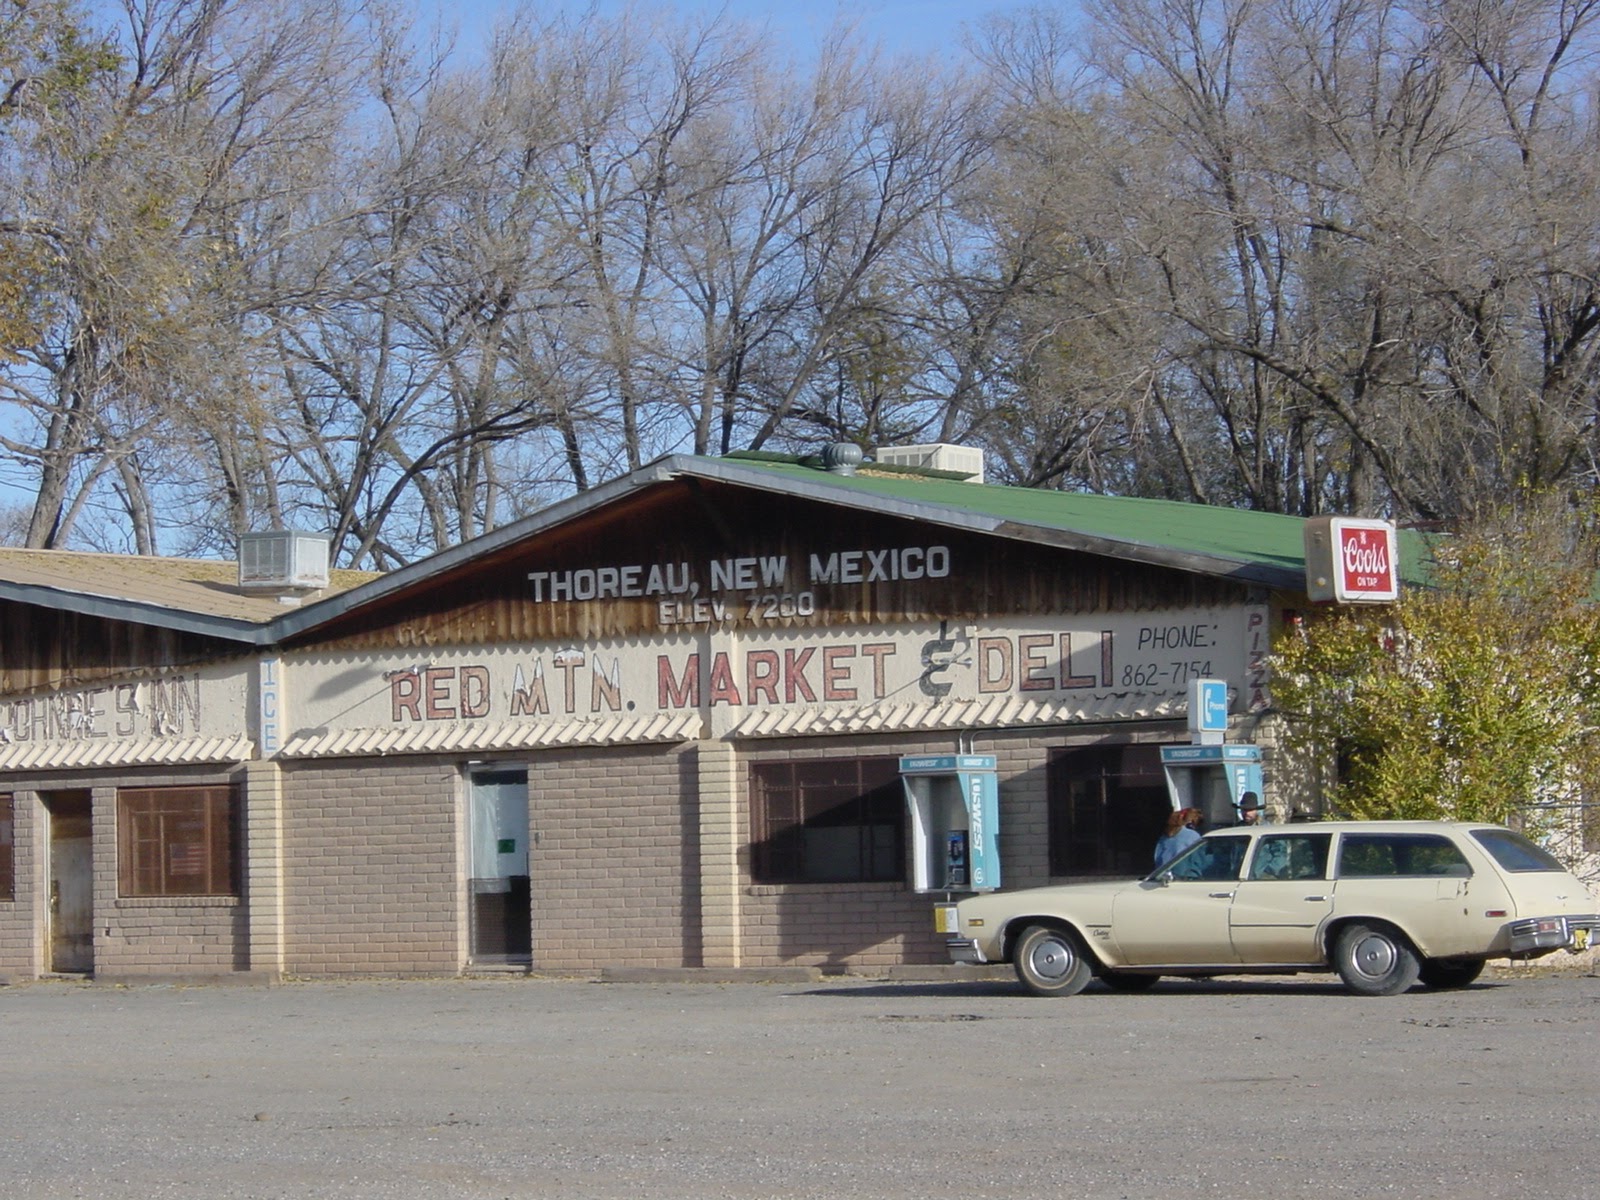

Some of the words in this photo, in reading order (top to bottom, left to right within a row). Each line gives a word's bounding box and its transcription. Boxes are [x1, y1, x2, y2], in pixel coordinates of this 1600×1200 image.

[527, 562, 700, 603] THOREAU,
[710, 555, 787, 592] NEW
[809, 545, 951, 585] MEXICO
[1343, 537, 1387, 574] Coors
[1357, 576, 1366, 587] ON
[1366, 577, 1378, 587] TAP
[658, 598, 733, 625] ELEV.
[745, 591, 815, 619] 7200
[1138, 624, 1218, 651] PHONE:
[1247, 612, 1268, 708] PIZZA
[391, 664, 491, 722] RED
[509, 648, 636, 716] MTN.
[656, 636, 898, 710] MARKET
[977, 629, 1114, 694] DELI
[1121, 660, 1213, 687] 862-7154
[150, 673, 201, 736] INN
[262, 658, 277, 751] ICE
